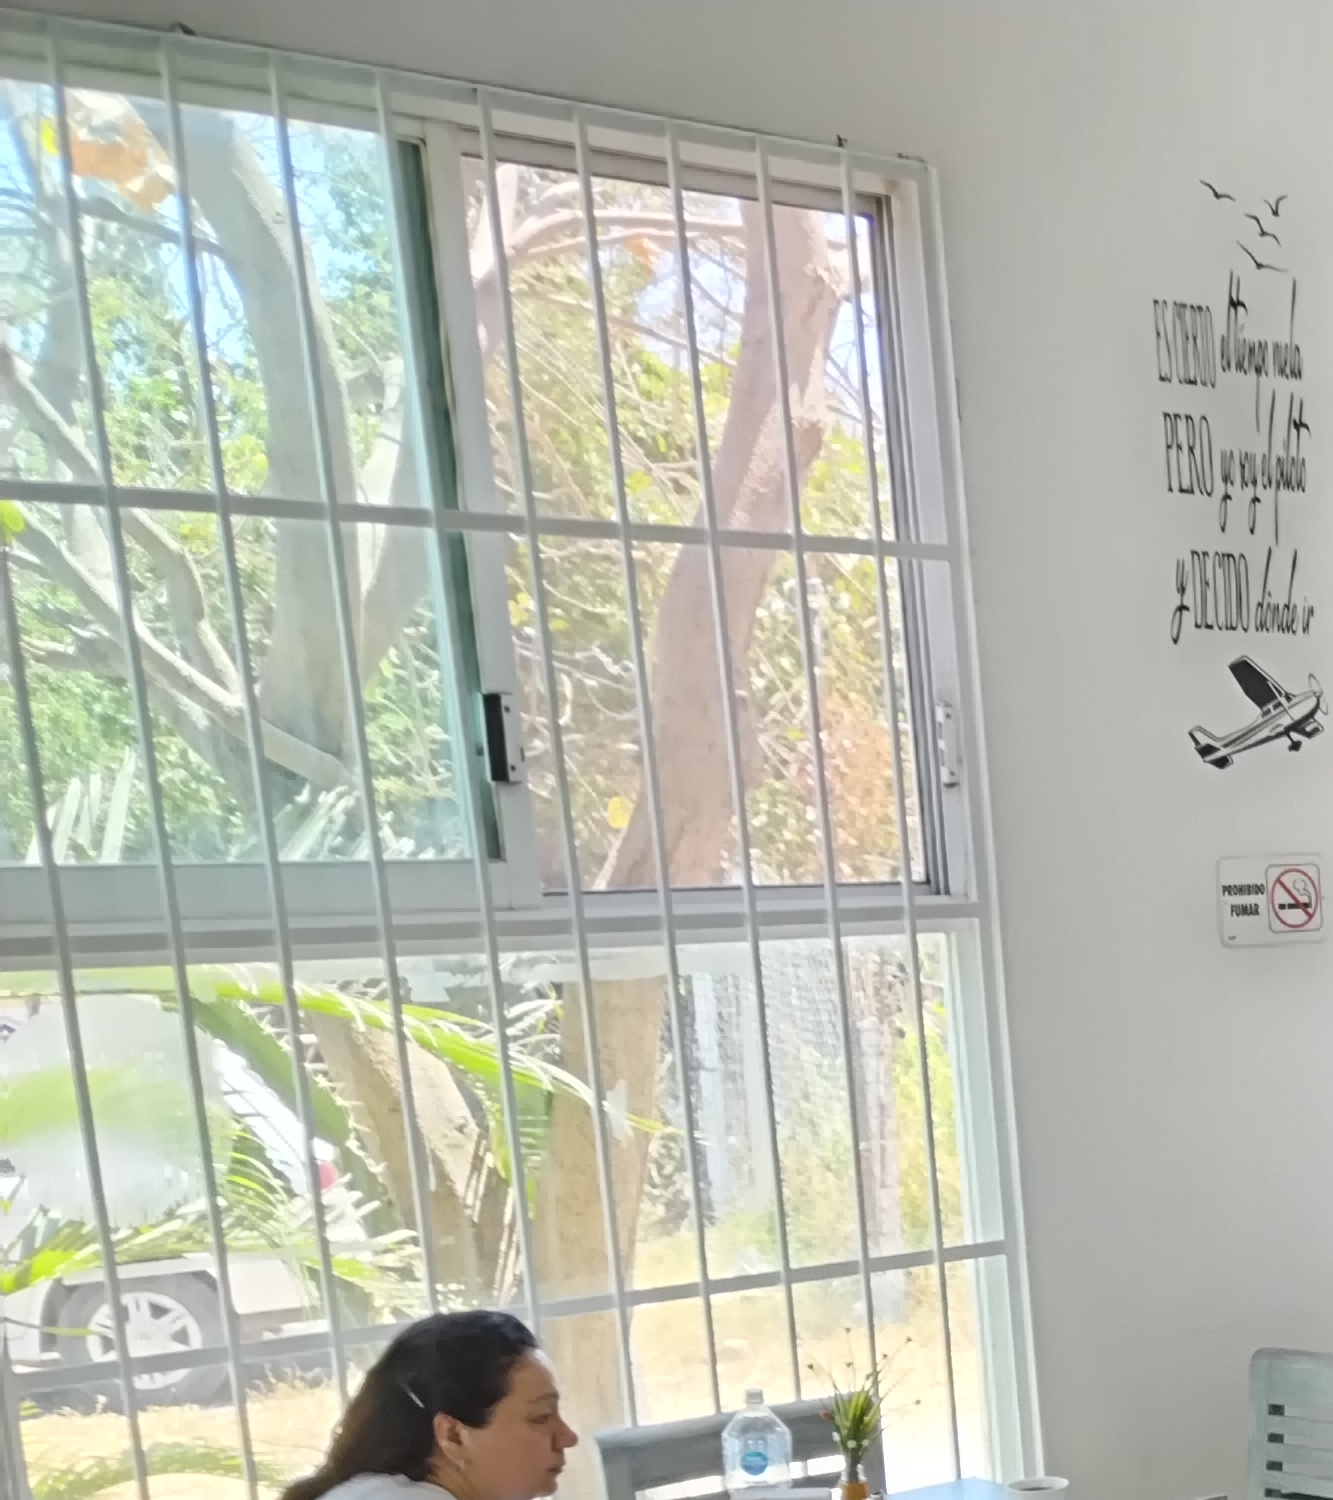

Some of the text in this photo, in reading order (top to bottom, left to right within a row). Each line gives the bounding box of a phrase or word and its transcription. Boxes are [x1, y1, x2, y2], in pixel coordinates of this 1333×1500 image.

[1153, 299, 1172, 383] ES
[1162, 411, 1214, 497] PERO
[1218, 448, 1235, 533] yo
[1261, 388, 1275, 490] el
[1170, 558, 1190, 645] y
[1190, 549, 1250, 633] DECIDO
[1302, 595, 1315, 636] ir
[1222, 884, 1265, 896] PROHIBIDO
[1230, 903, 1260, 917] FUMAR
